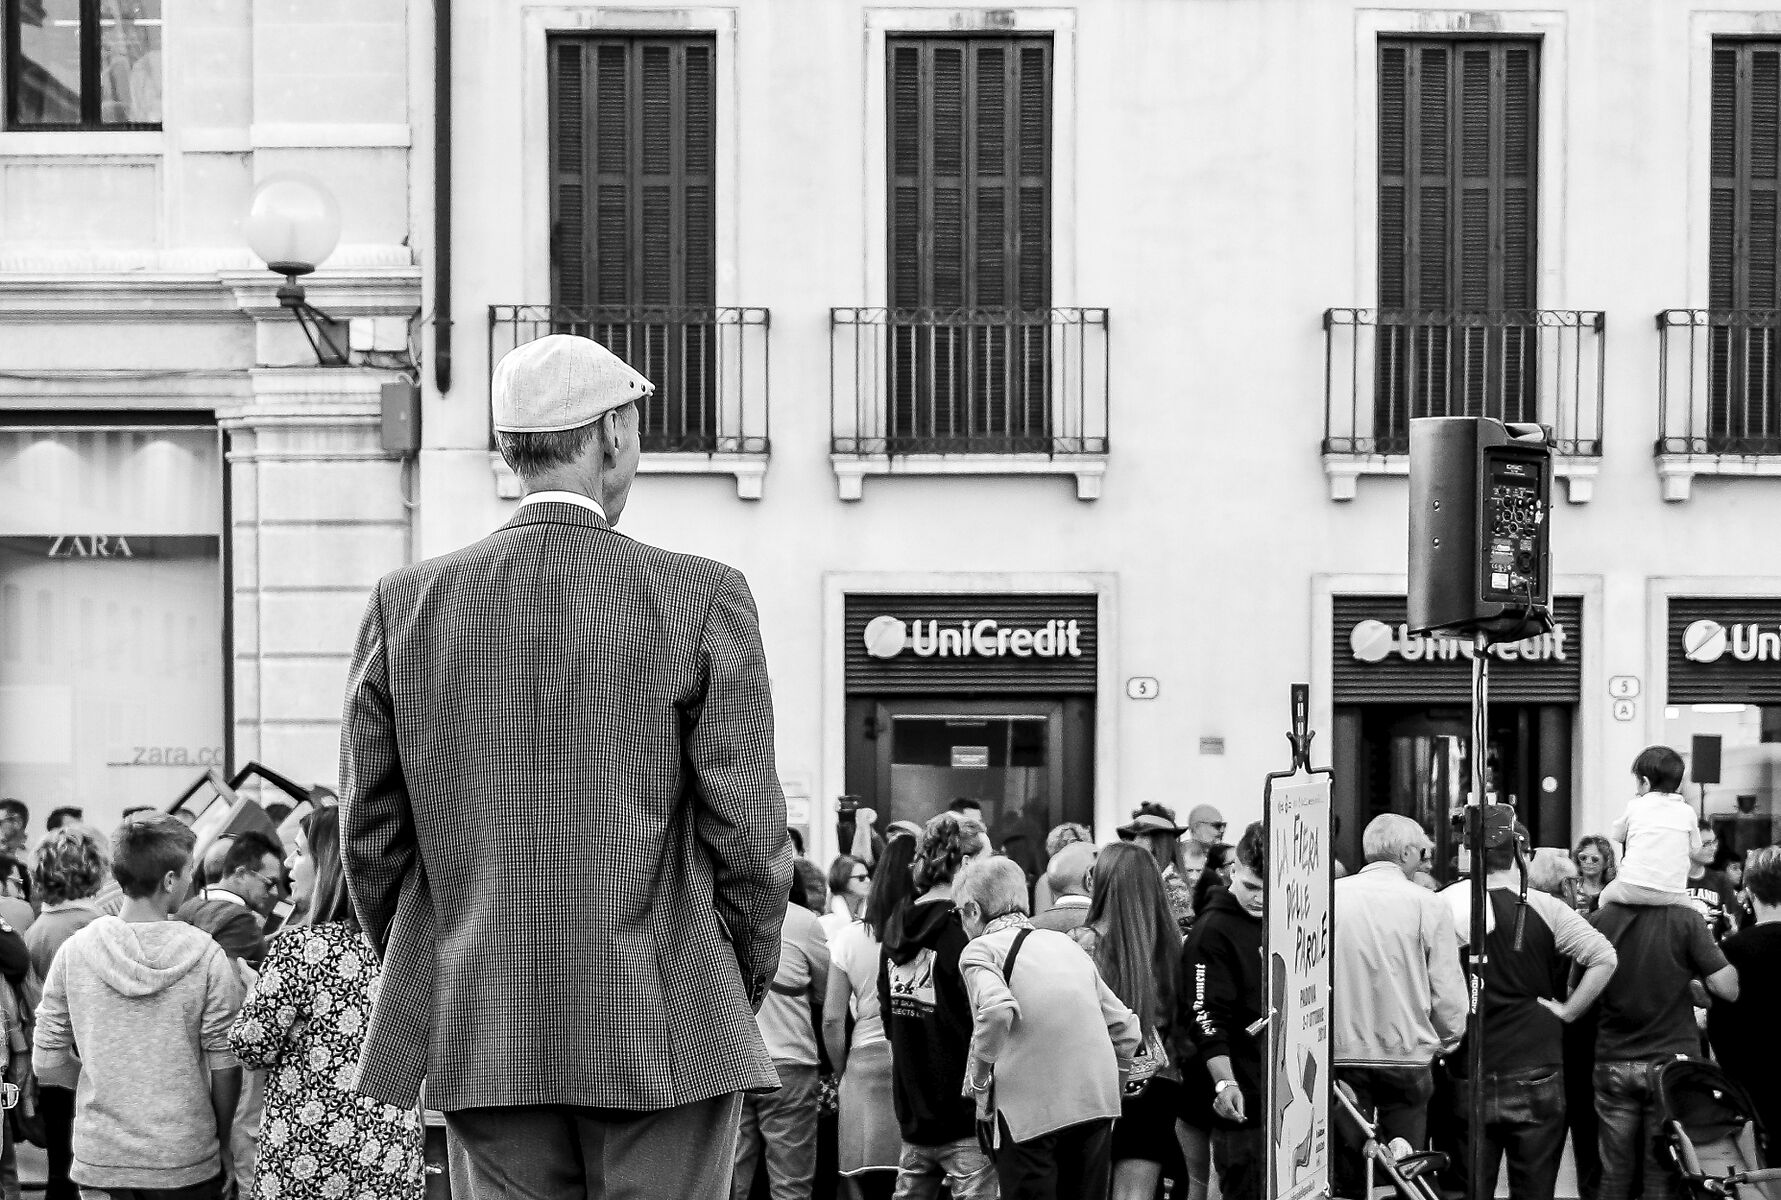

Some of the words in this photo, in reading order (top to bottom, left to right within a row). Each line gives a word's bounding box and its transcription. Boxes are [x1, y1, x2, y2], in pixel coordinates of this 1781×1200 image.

[48, 534, 134, 557] ZARA
[912, 619, 1082, 657] UniCredit
[1732, 623, 1781, 661] Un
[1139, 681, 1146, 694] 5
[1621, 680, 1628, 693] 5
[1620, 705, 1629, 715] A
[1276, 828, 1289, 888] LA
[1293, 813, 1319, 877] FIERA
[1294, 910, 1327, 978] PAROLE
